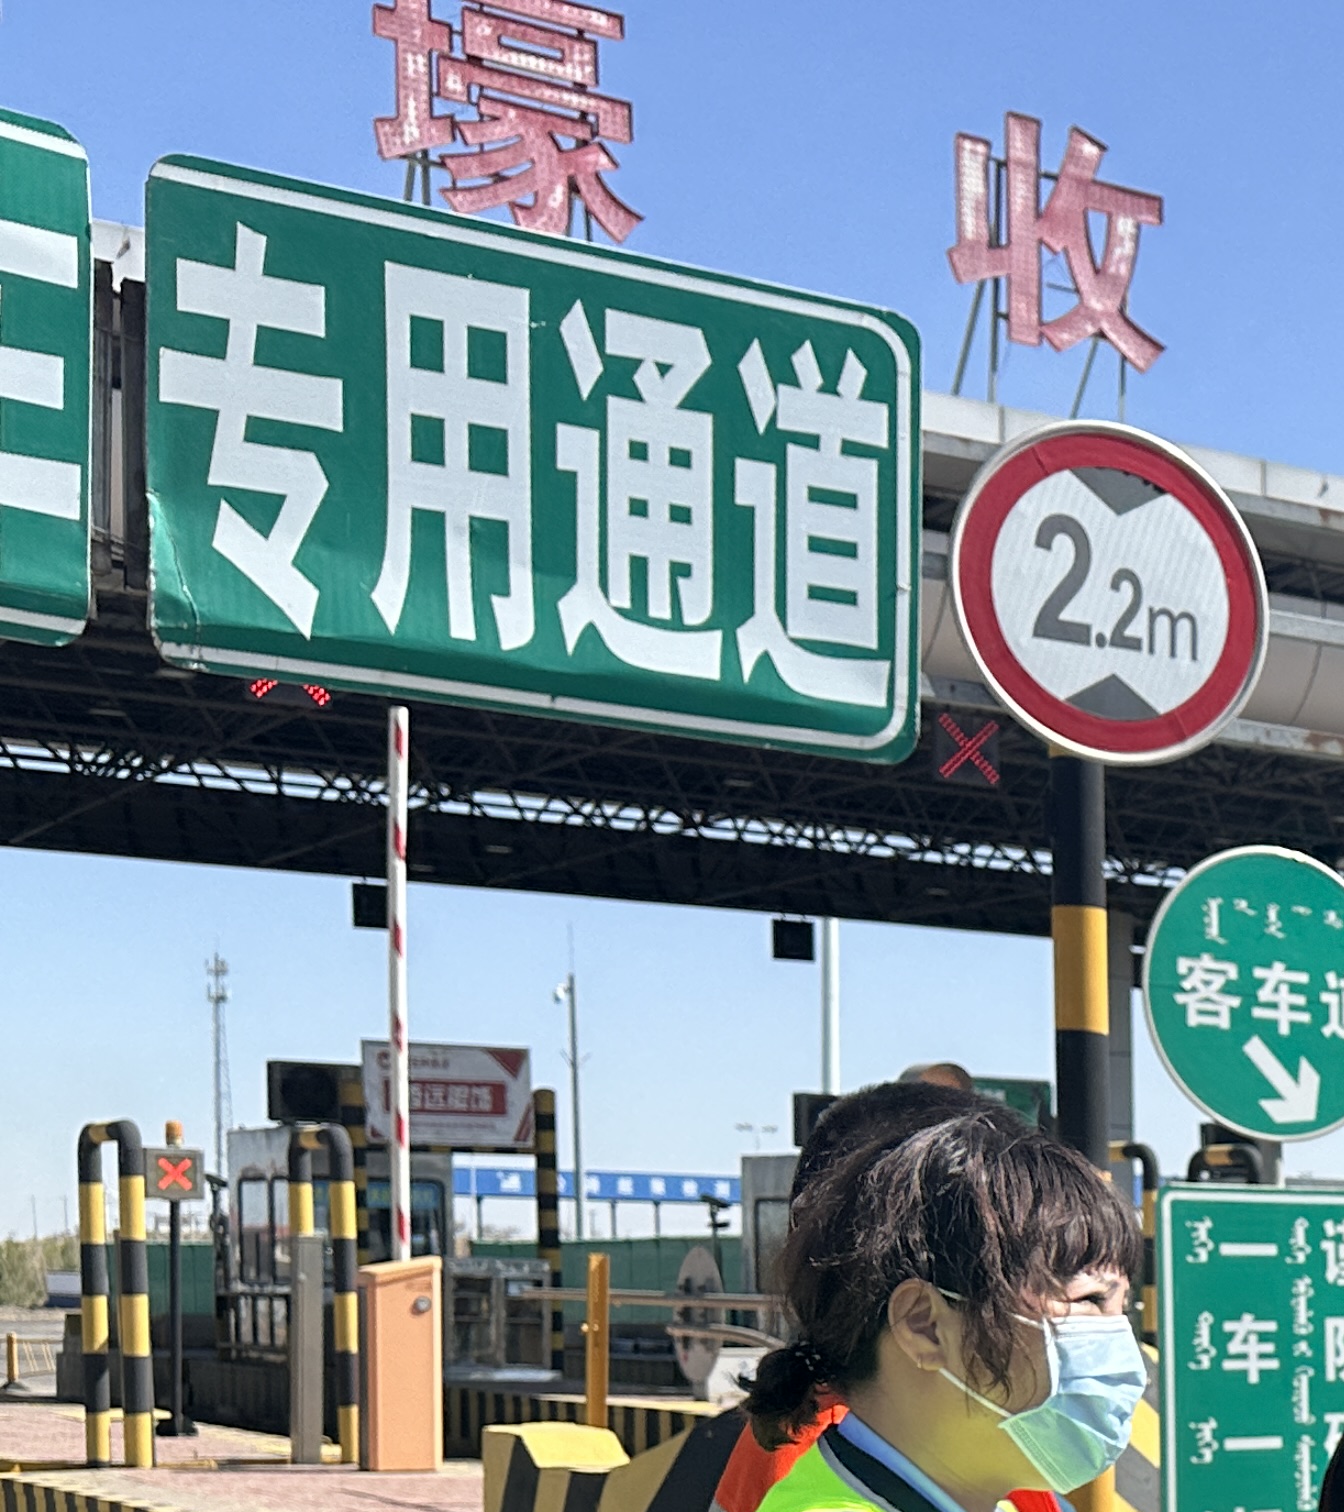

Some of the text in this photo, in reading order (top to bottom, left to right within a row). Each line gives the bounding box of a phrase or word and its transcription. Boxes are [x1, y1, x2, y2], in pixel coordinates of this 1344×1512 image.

[159, 221, 891, 708] 专用通道
[1031, 512, 1198, 663] 2.2m
